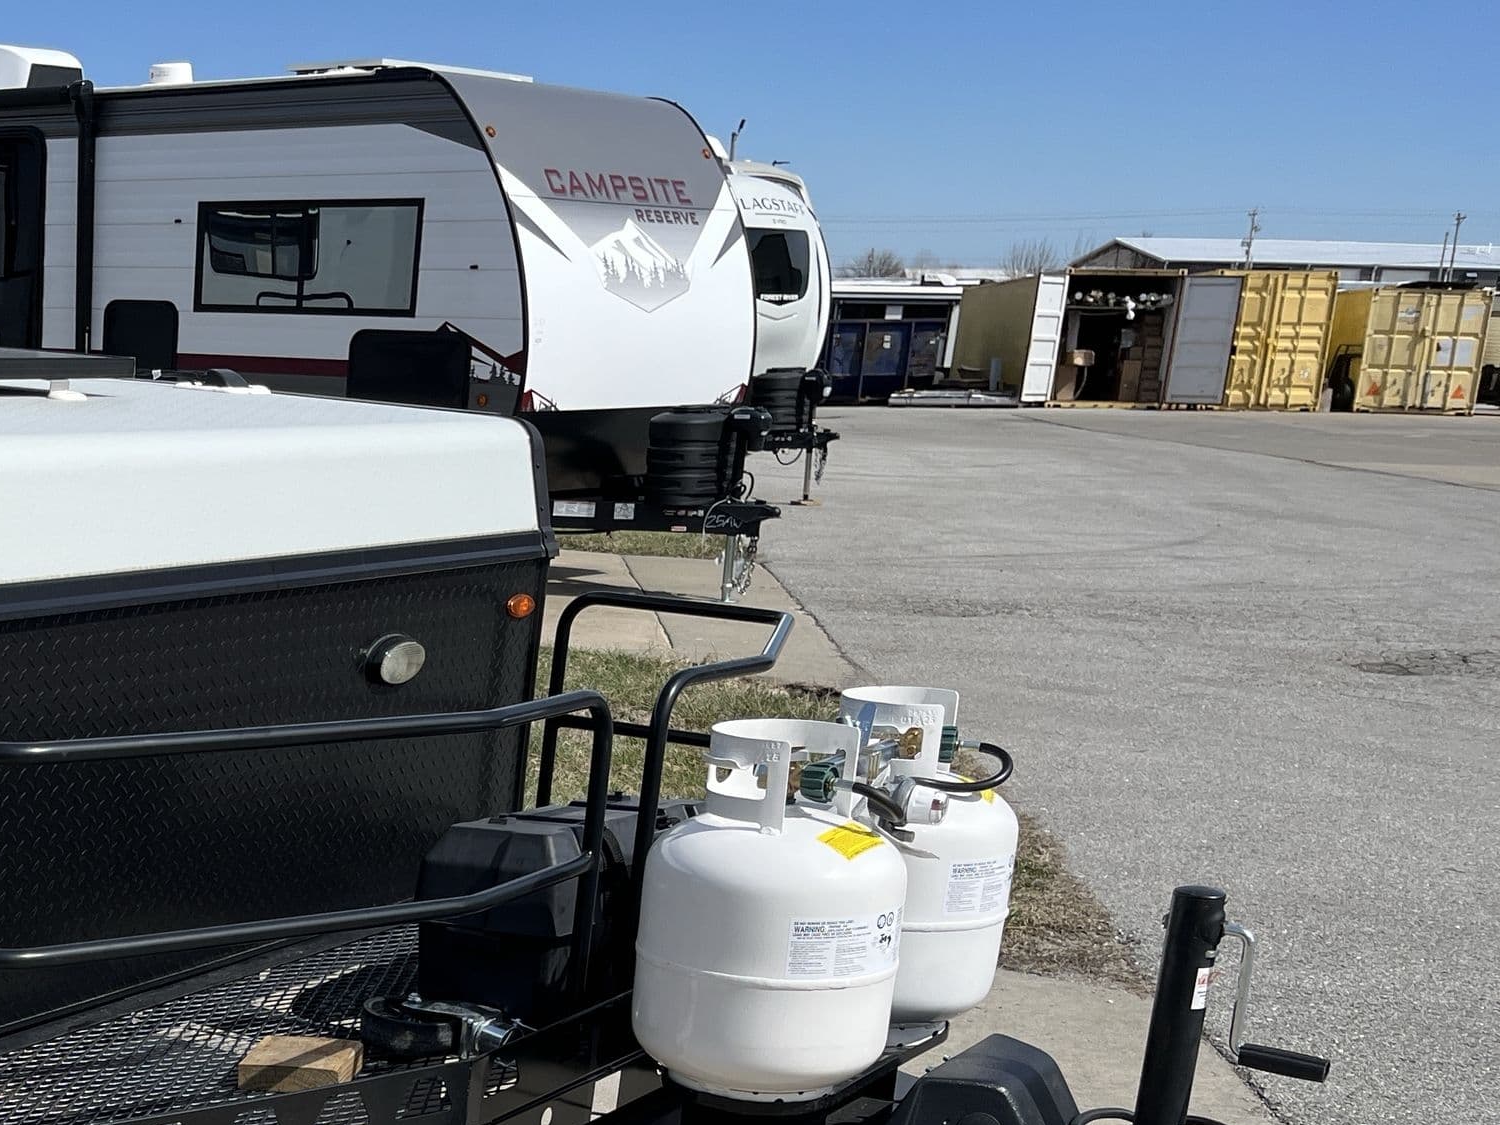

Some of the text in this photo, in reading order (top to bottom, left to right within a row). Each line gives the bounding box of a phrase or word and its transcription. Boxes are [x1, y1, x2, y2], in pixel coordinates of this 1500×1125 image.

[544, 168, 694, 206] CAMPSITE
[739, 197, 805, 215] LAGSTAFF
[634, 208, 699, 226] RESERVE
